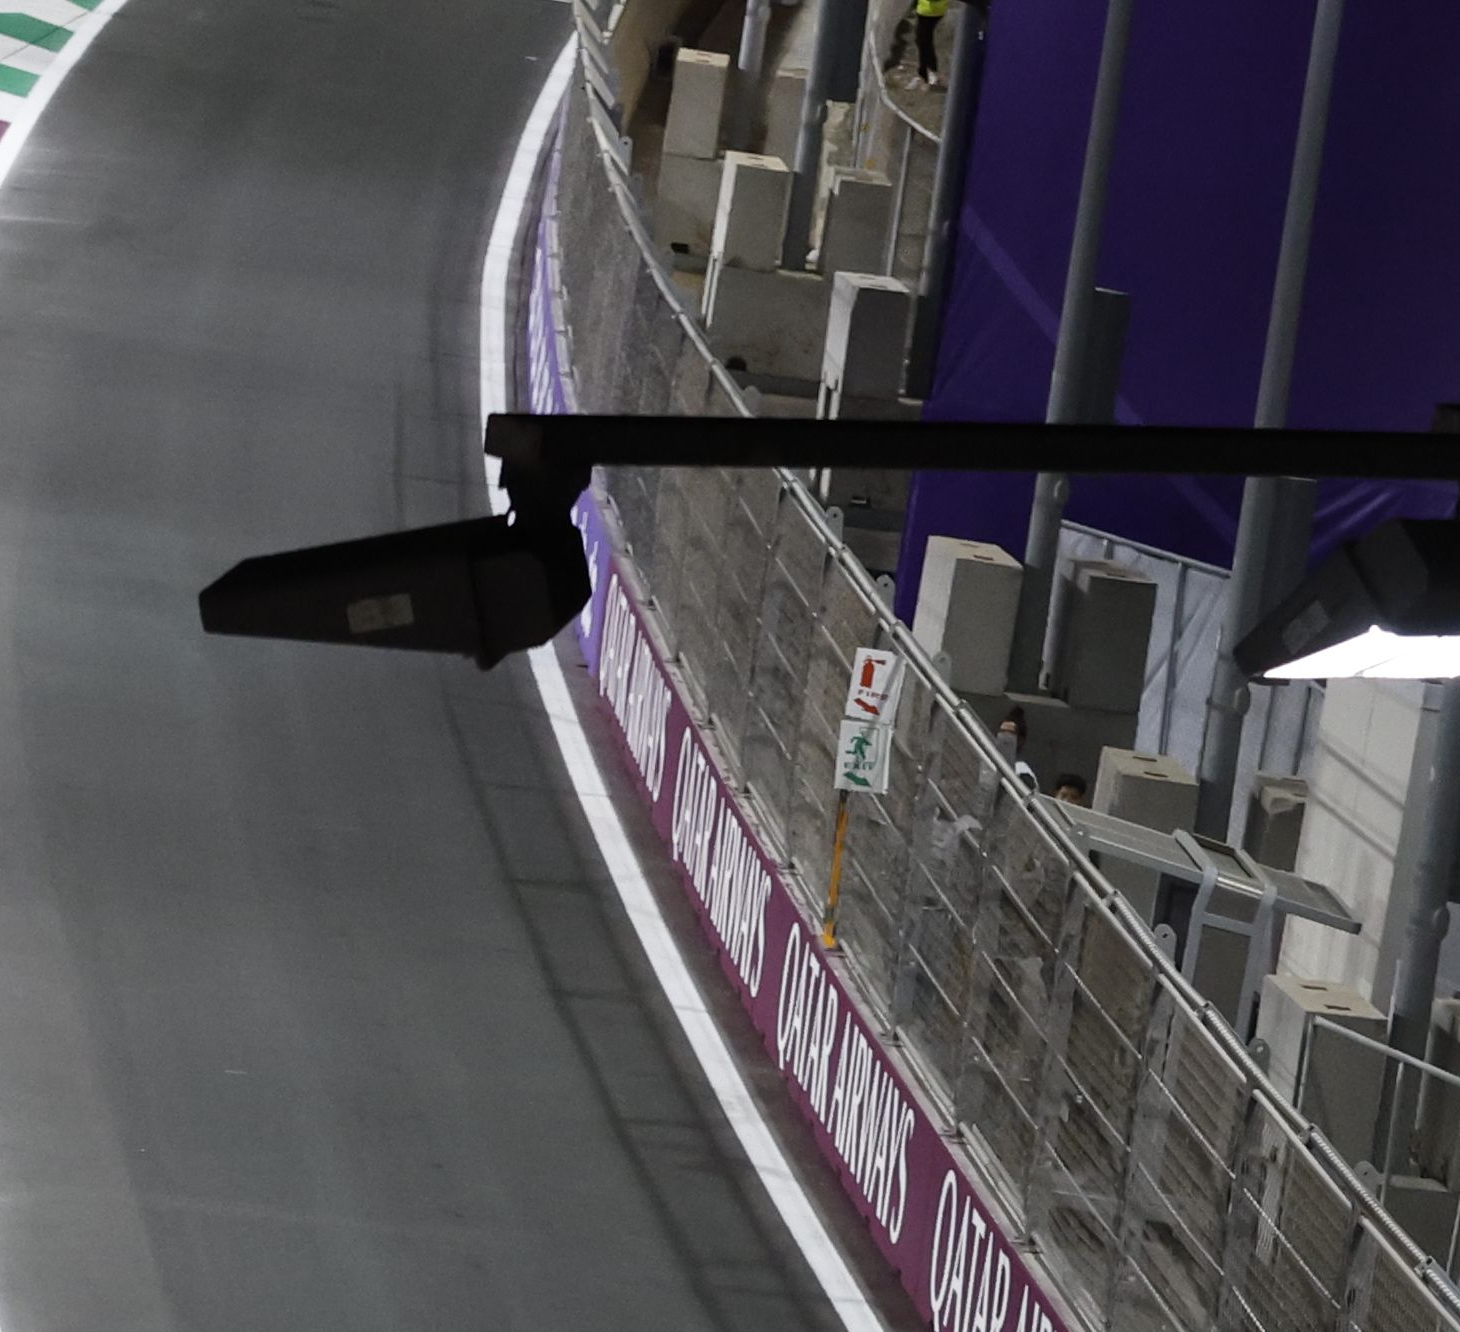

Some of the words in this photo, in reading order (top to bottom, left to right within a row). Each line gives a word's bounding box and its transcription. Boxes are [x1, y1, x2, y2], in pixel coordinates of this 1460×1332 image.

[673, 727, 719, 908] QATAR
[706, 797, 772, 998] AIRWAYS
[778, 922, 839, 1118] QATAR
[827, 1010, 915, 1244] AIRWAYS
